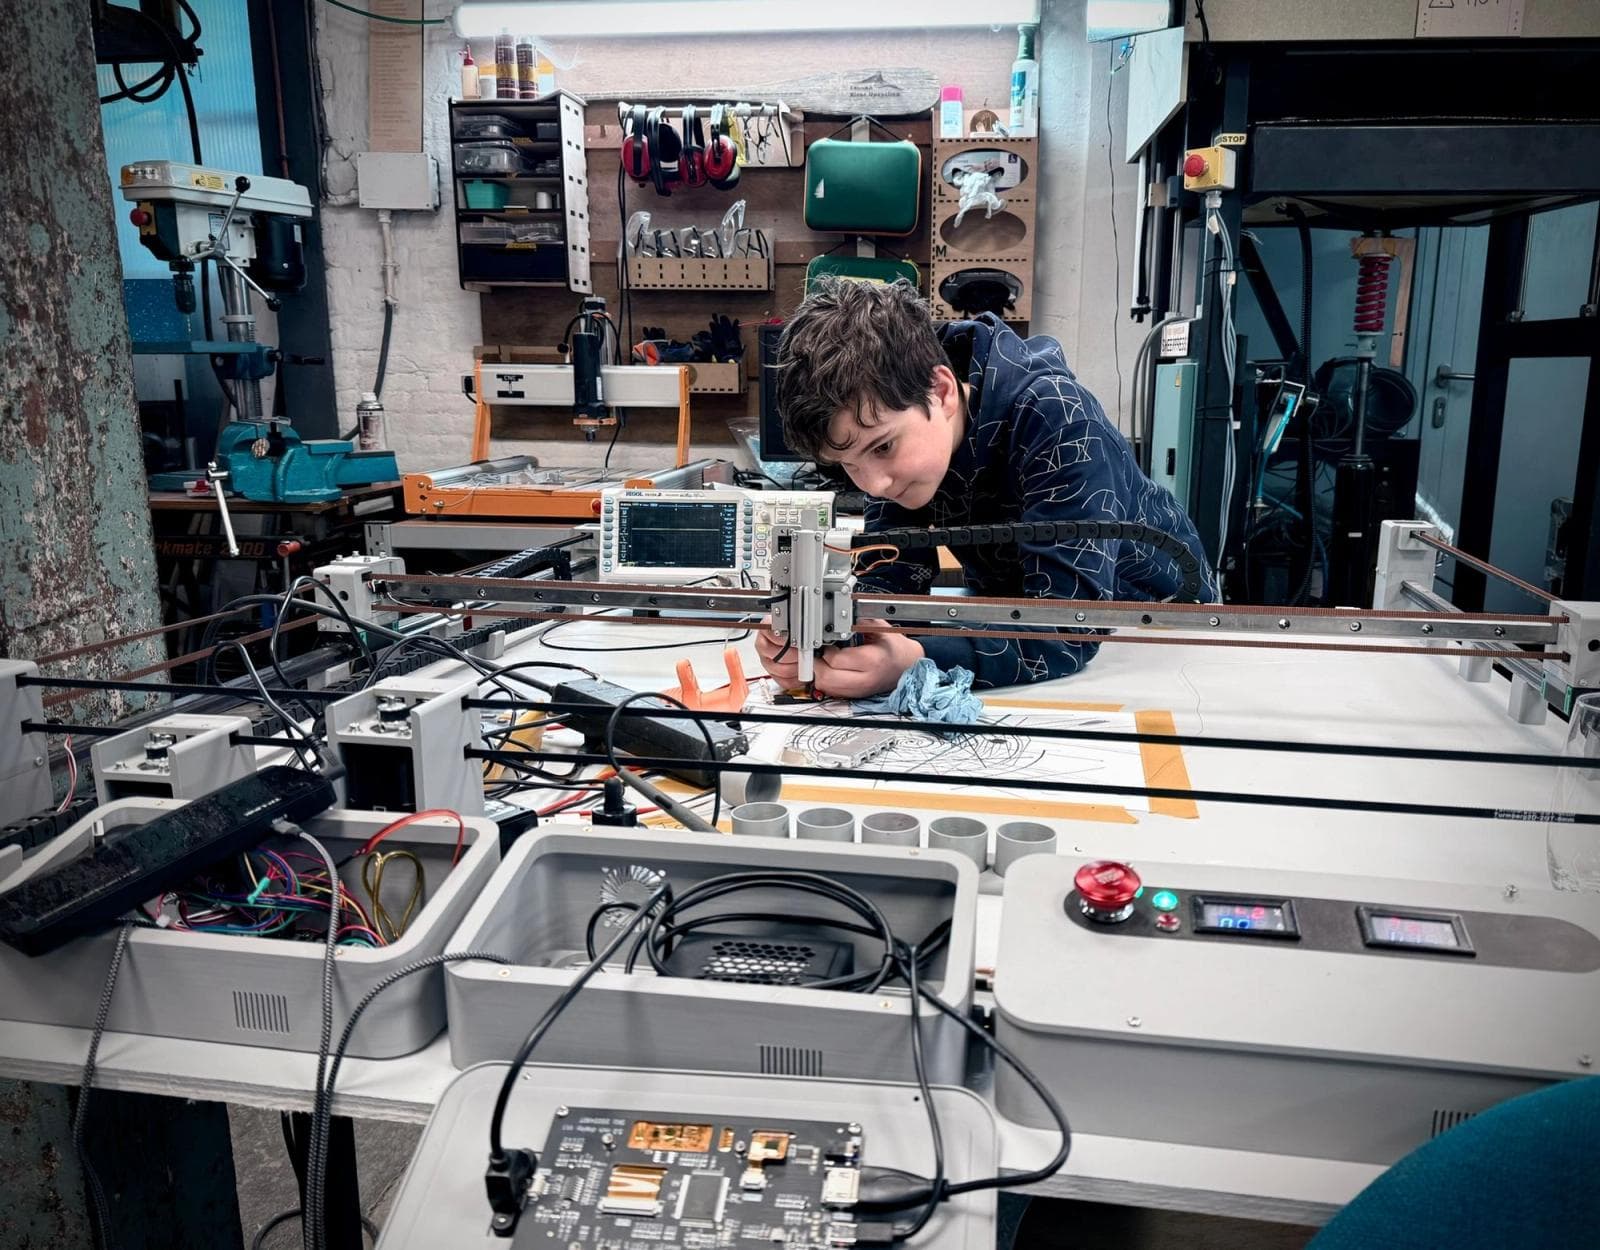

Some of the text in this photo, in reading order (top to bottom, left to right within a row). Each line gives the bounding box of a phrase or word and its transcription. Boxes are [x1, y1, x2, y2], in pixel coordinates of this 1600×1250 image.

[1222, 135, 1245, 143] STOP
[938, 184, 946, 197] L
[935, 245, 947, 258] M
[935, 304, 944, 316] S
[155, 539, 265, 556] rkmate 200
